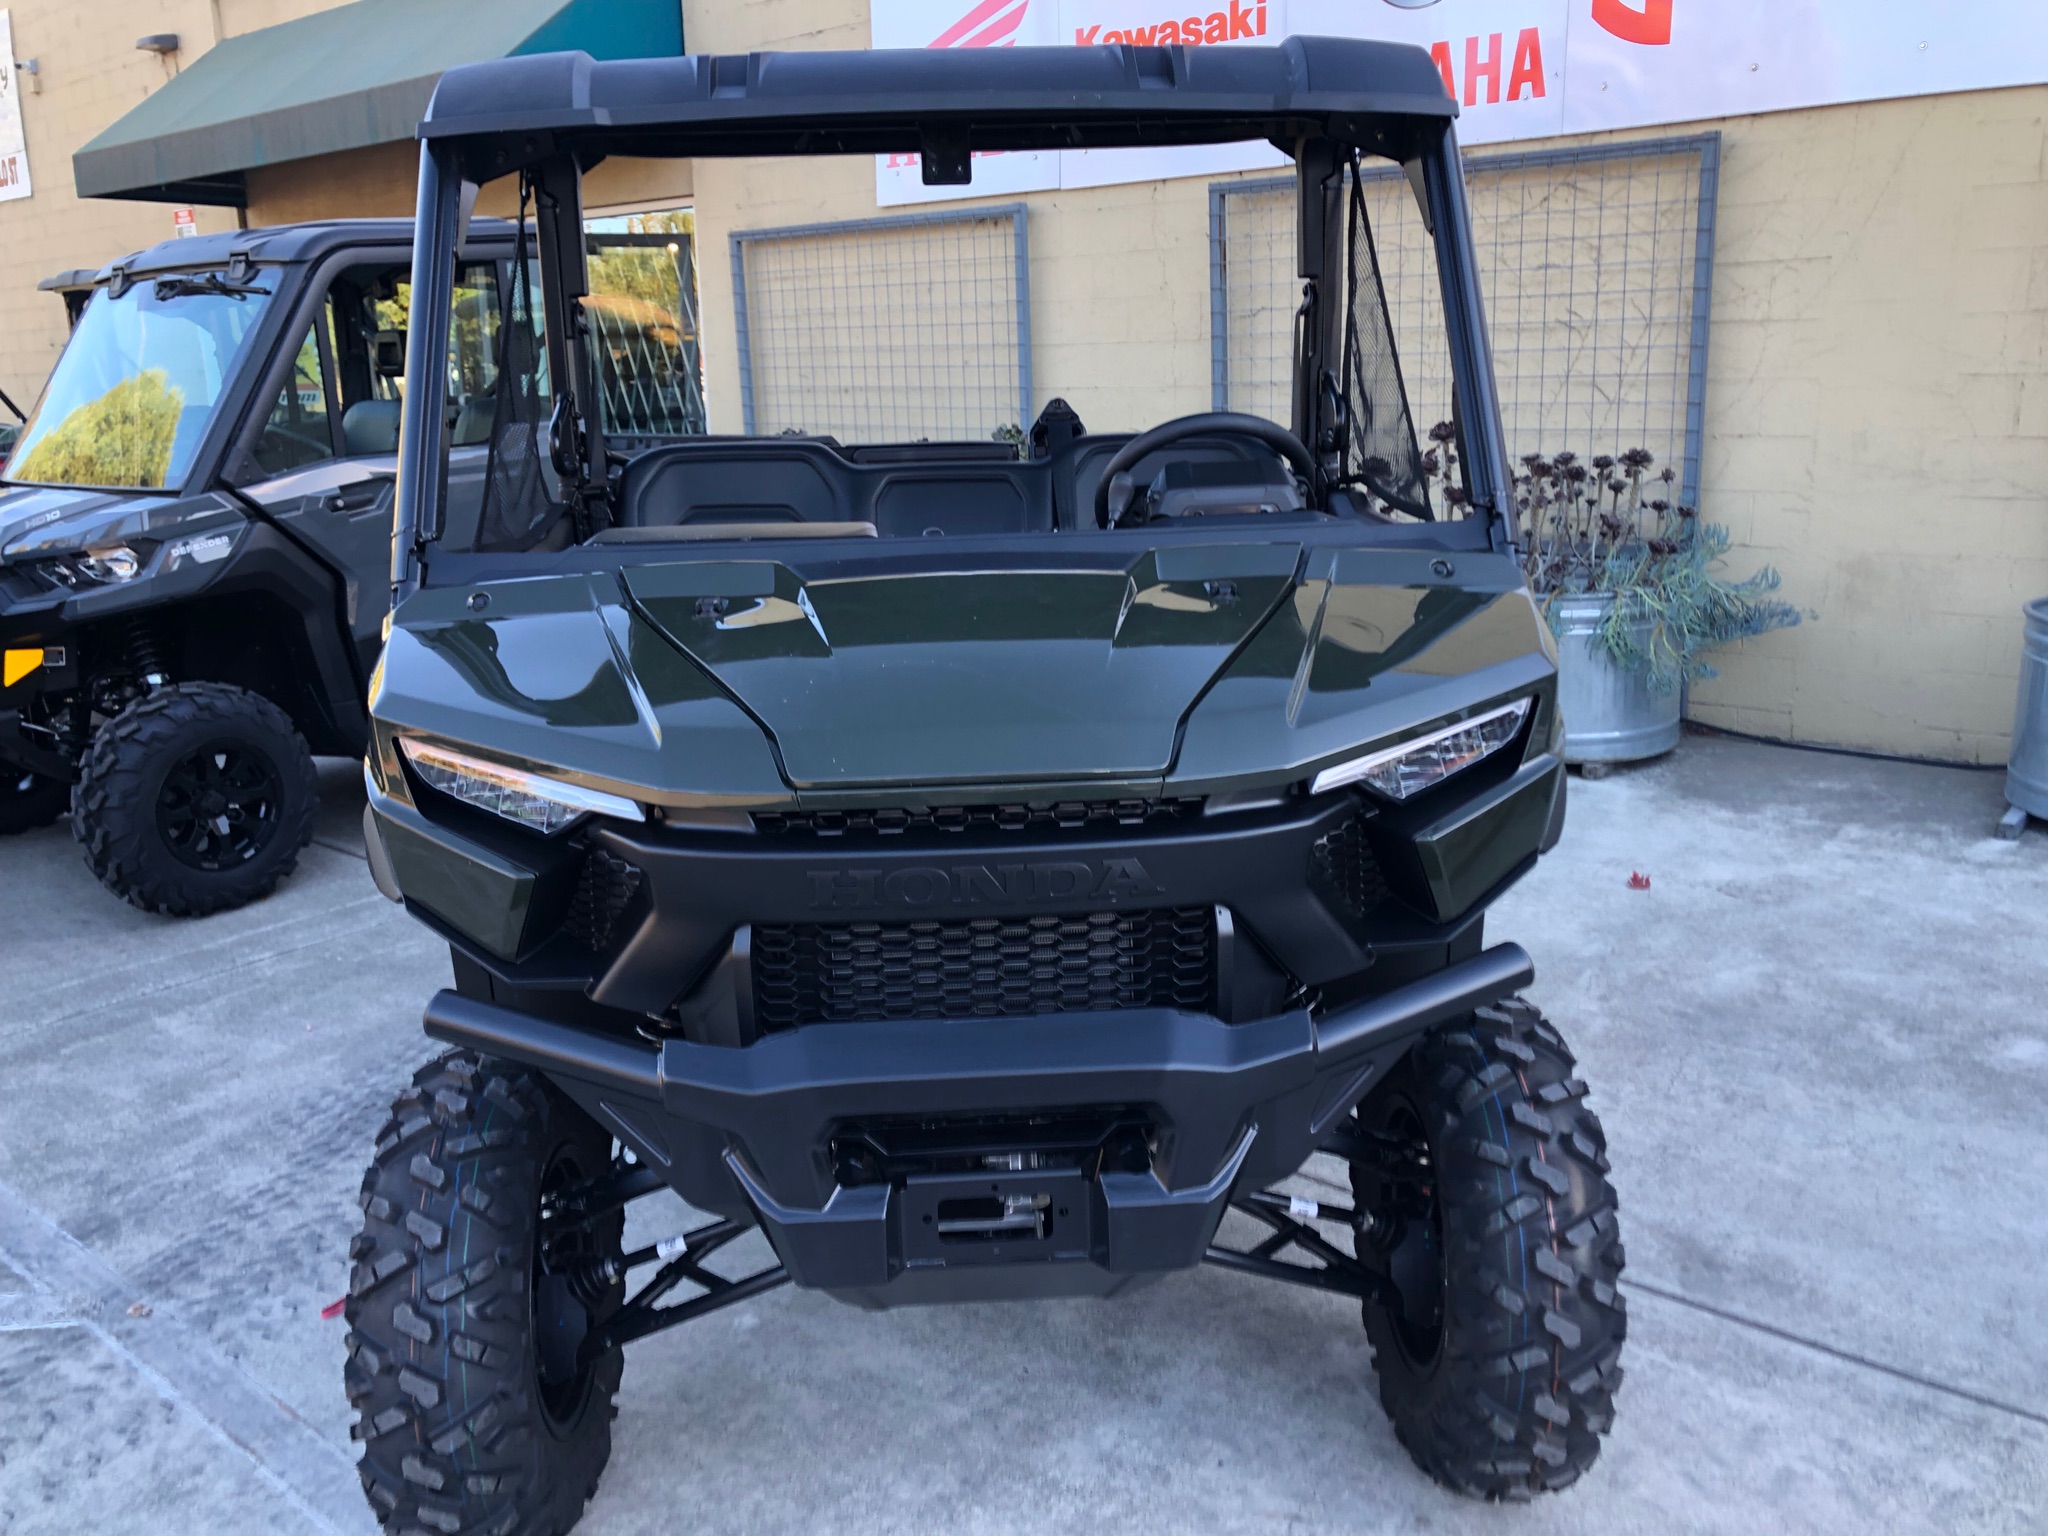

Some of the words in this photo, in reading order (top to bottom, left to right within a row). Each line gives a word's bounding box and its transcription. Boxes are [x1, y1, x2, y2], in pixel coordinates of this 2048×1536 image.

[1430, 27, 1546, 107] AHA
[170, 535, 230, 557] DEFENDER
[806, 857, 1166, 908] HONDA
